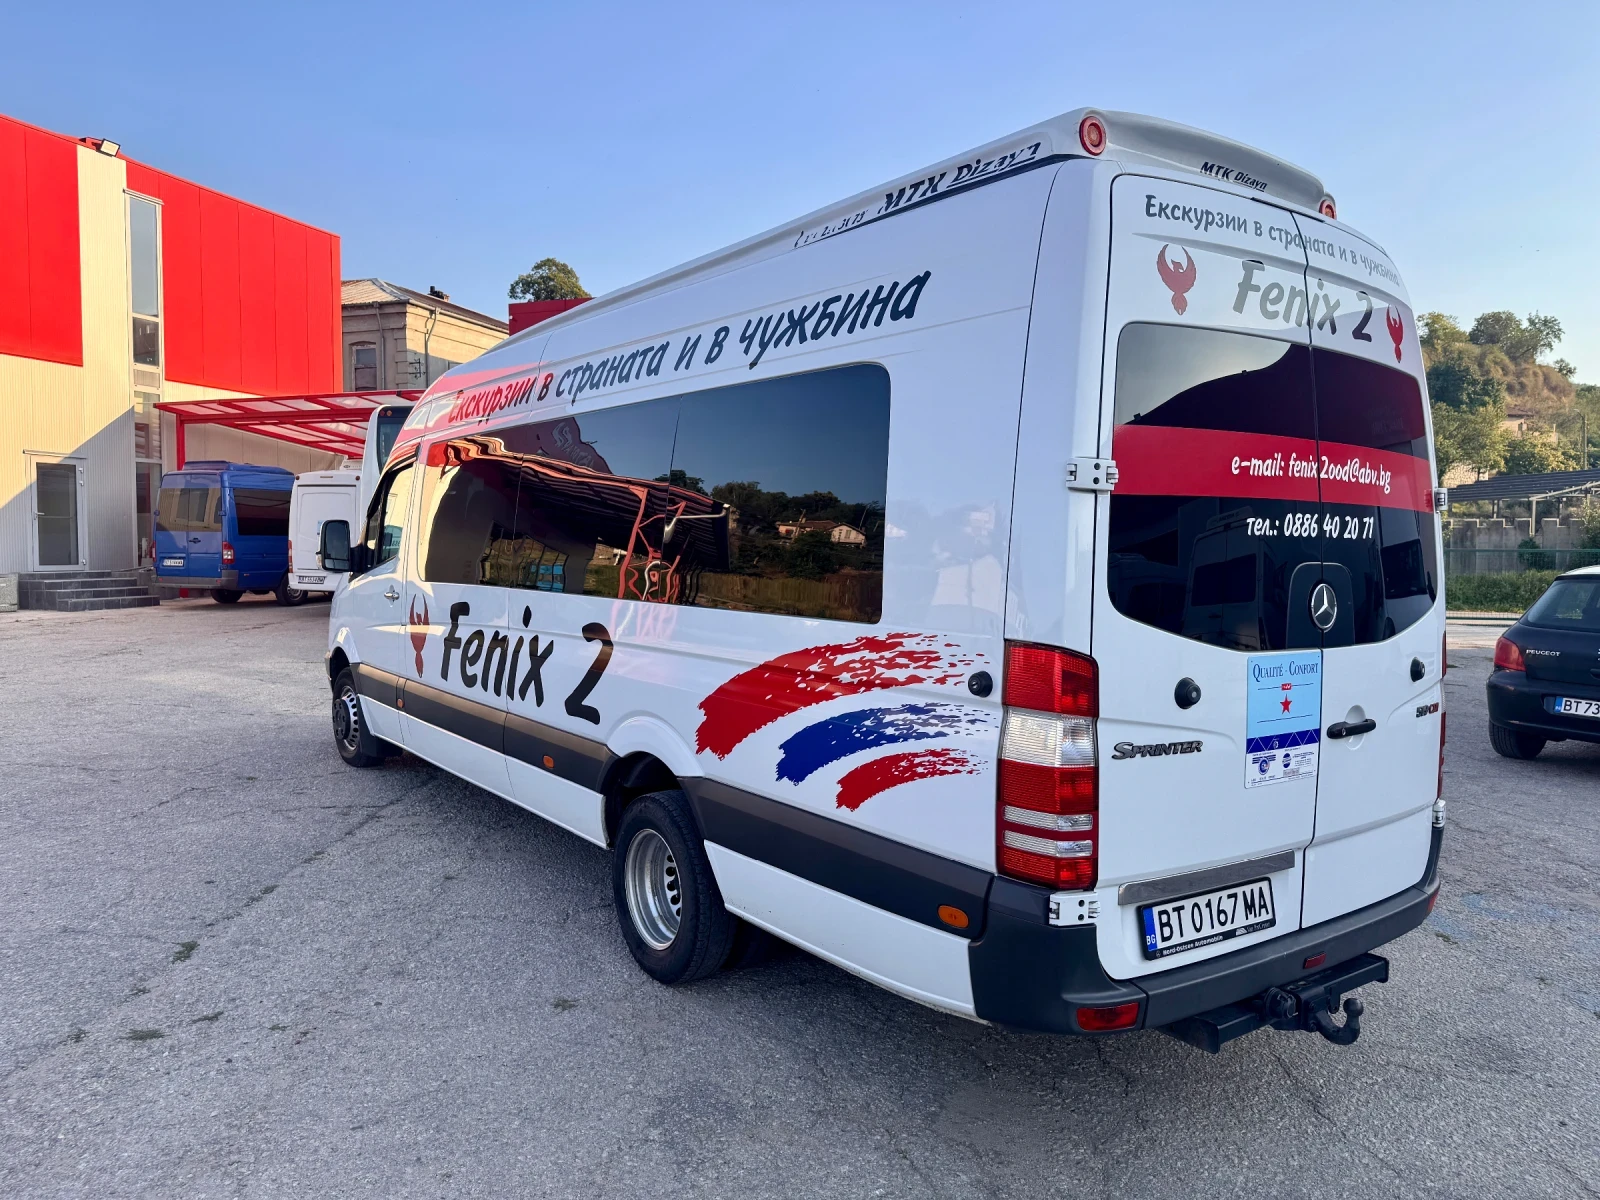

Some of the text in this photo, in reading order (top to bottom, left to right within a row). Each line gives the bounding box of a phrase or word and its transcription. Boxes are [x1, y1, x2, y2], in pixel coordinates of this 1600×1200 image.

[1200, 161, 1268, 191] MTK Dizayn
[1144, 194, 1248, 234] Екскурзии
[1254, 220, 1263, 237] в
[1268, 223, 1336, 259] страната
[1338, 245, 1348, 262] и
[1350, 249, 1358, 265] в
[1232, 259, 1373, 343] Fenix 2
[448, 270, 932, 427] Екскурзии в страната и в чужбина
[1231, 453, 1285, 477] e-mail:
[1246, 516, 1279, 536] тел.:
[1283, 513, 1319, 537] 0886
[1322, 513, 1341, 539] 40
[1343, 515, 1359, 540] 20
[1362, 516, 1375, 540] 71
[440, 601, 615, 726] Fenix 2
[1525, 648, 1561, 657] PEUGEOT
[1563, 699, 1582, 713] BT
[1157, 886, 1270, 943] BT 0167 MA
[1146, 933, 1156, 946] BG
